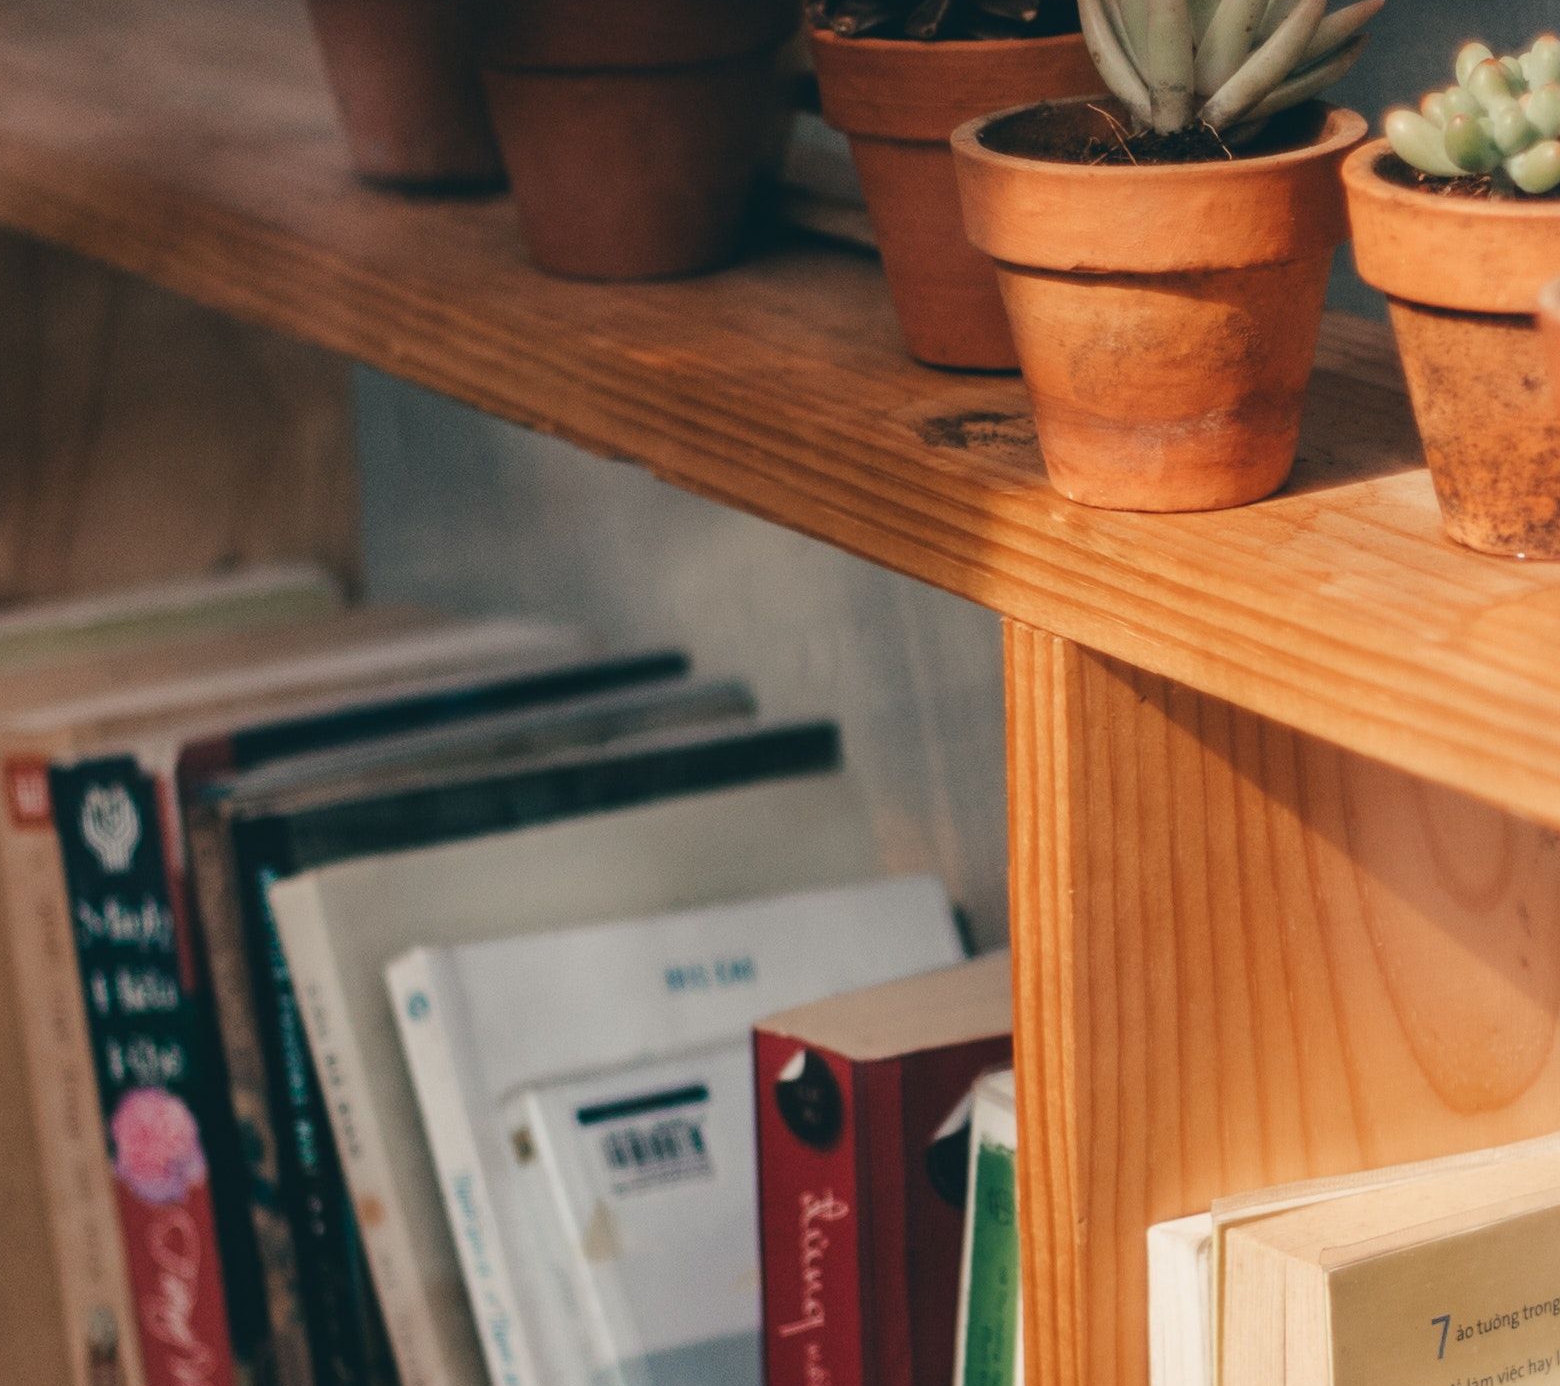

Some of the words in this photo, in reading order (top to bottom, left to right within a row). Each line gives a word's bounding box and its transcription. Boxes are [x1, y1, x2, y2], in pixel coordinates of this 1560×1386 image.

[1431, 1314, 1451, 1360] 7
[1497, 1363, 1524, 1385] việc
[1528, 1354, 1554, 1376] hay
